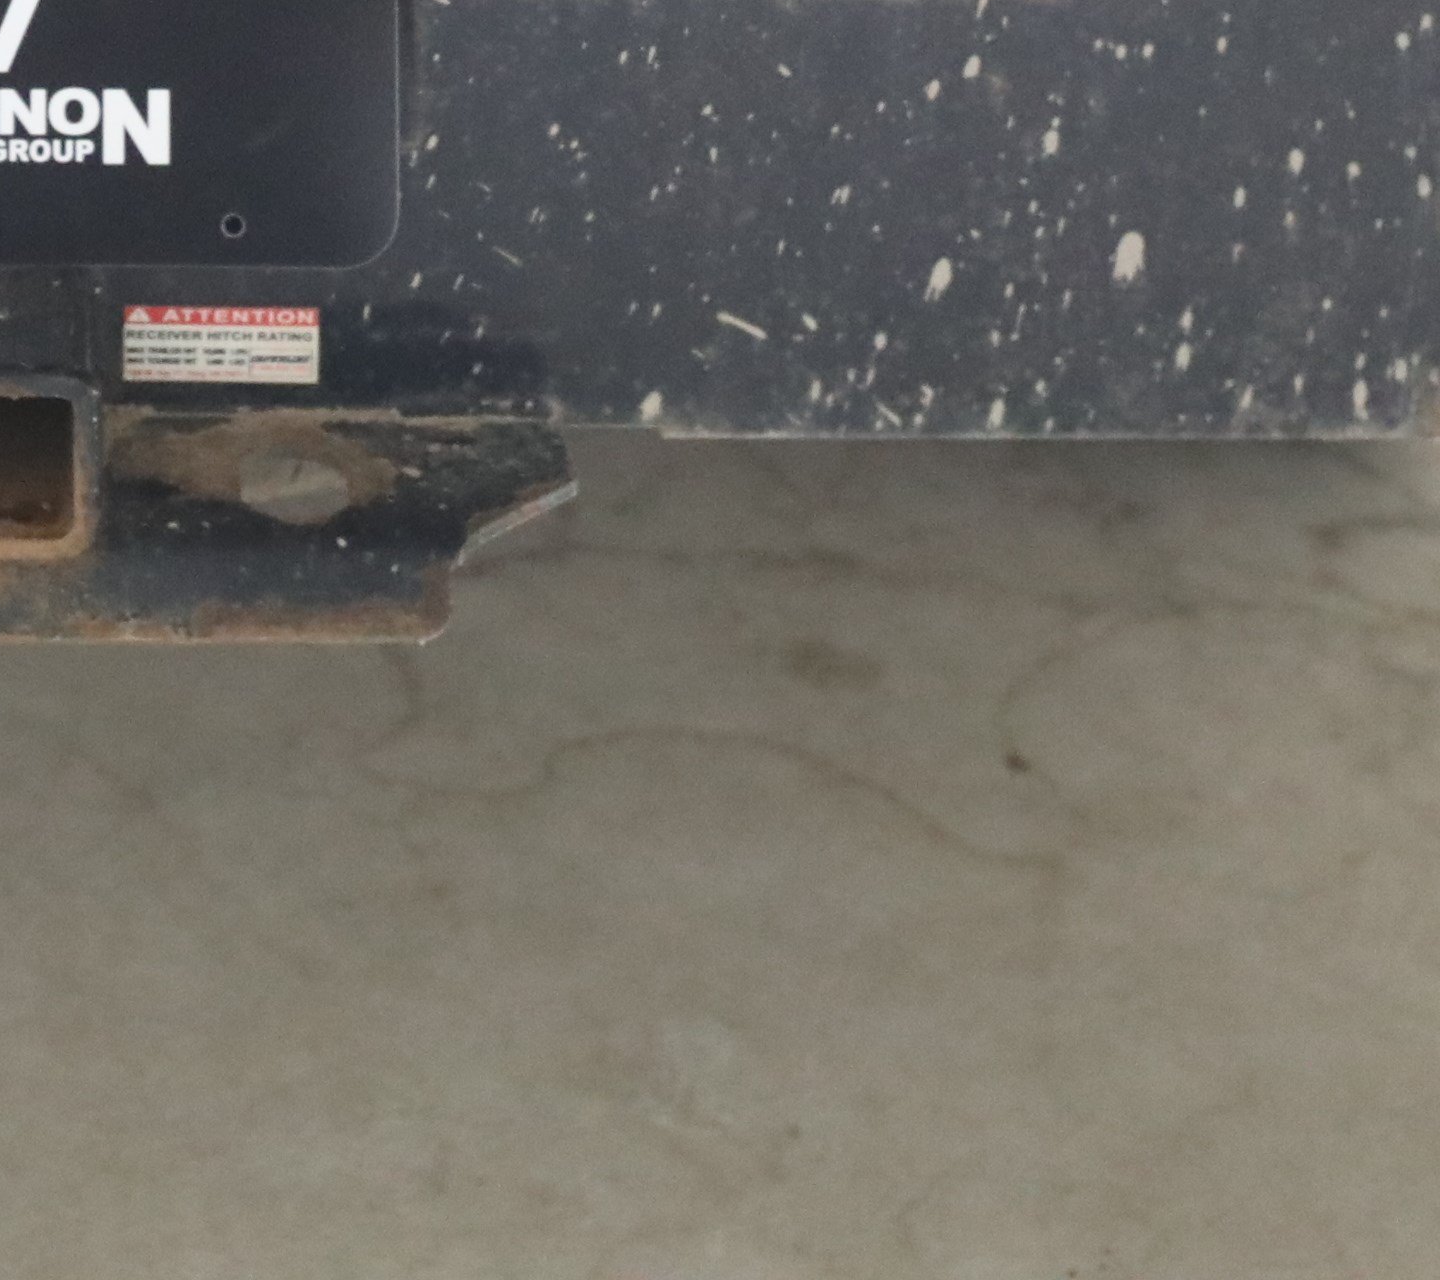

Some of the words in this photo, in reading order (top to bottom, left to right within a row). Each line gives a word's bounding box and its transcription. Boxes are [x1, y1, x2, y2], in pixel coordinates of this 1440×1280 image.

[162, 308, 314, 324] ATTENTION
[125, 330, 203, 340] RECEIVER
[207, 331, 253, 341] HITCH
[257, 332, 313, 342] RATING
